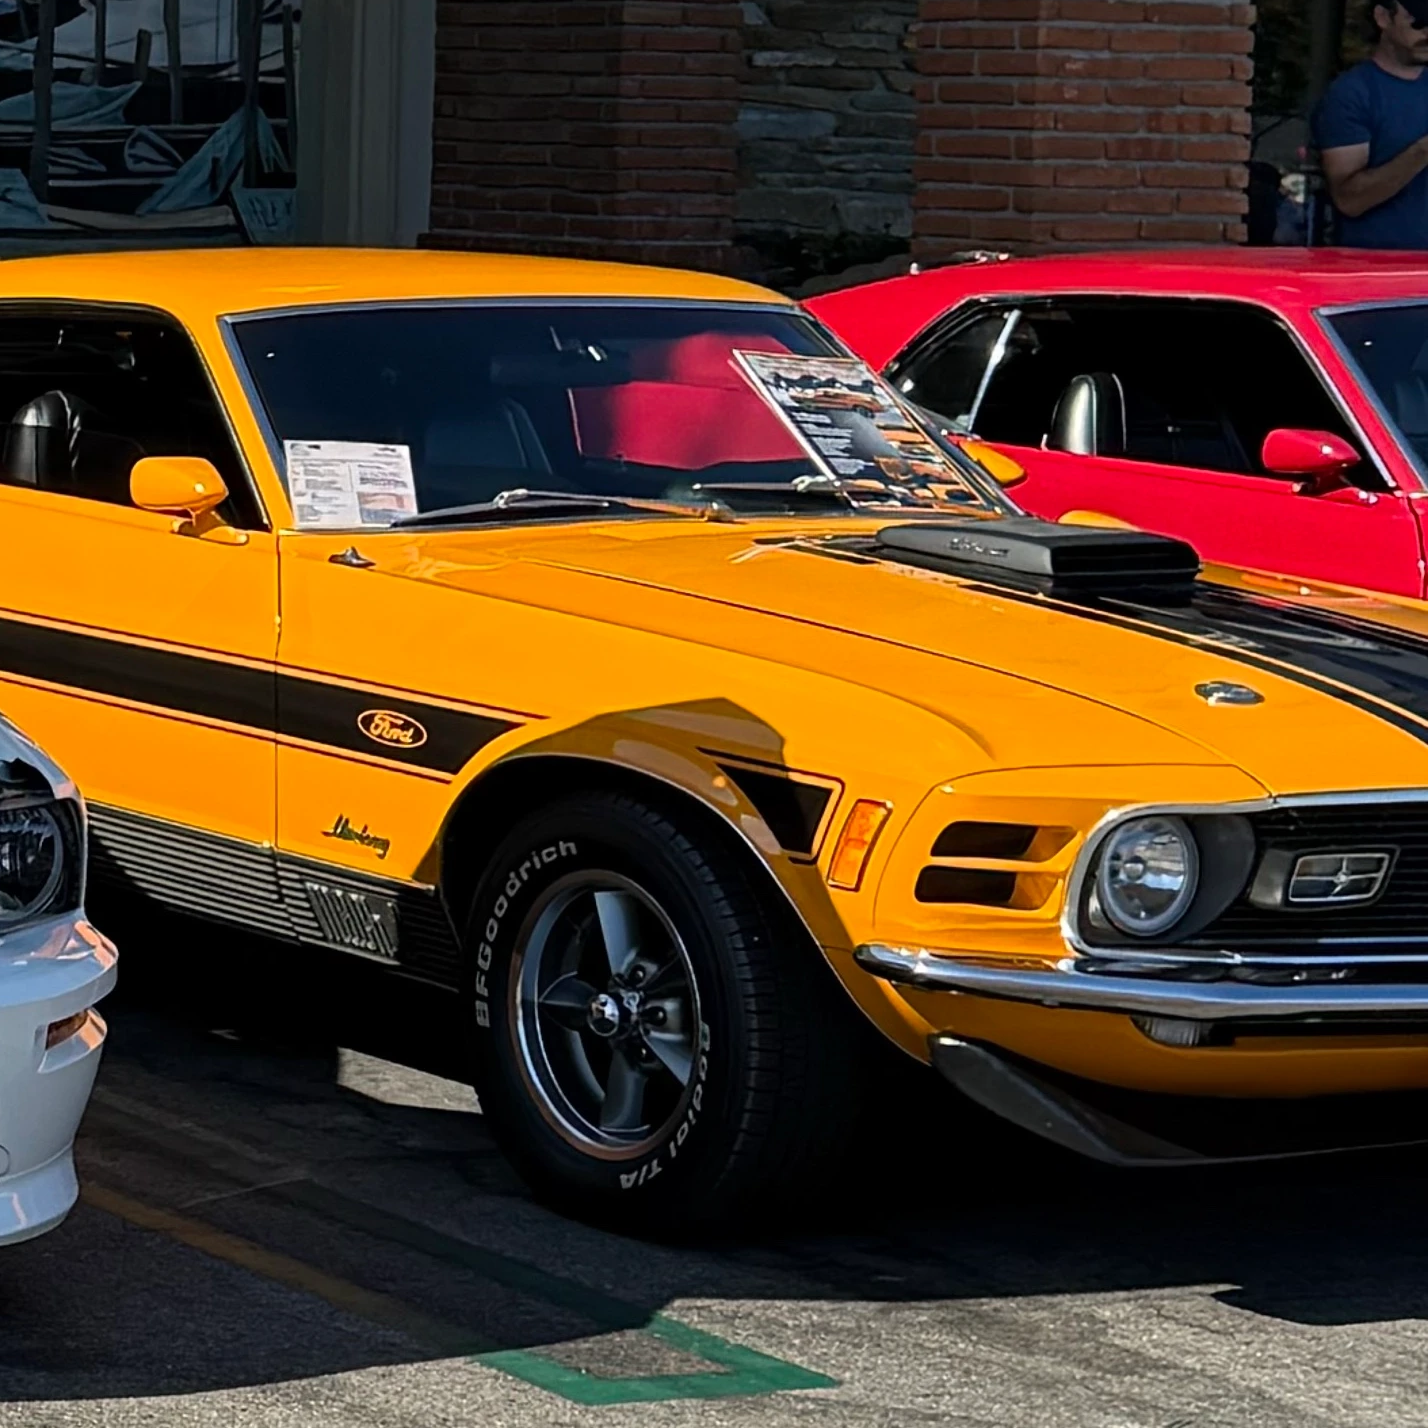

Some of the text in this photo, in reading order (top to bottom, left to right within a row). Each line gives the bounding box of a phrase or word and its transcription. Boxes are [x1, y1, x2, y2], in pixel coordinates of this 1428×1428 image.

[370, 712, 415, 744] Ford
[475, 840, 578, 1028] BFGoodrich
[619, 1162, 663, 1189] T/A
